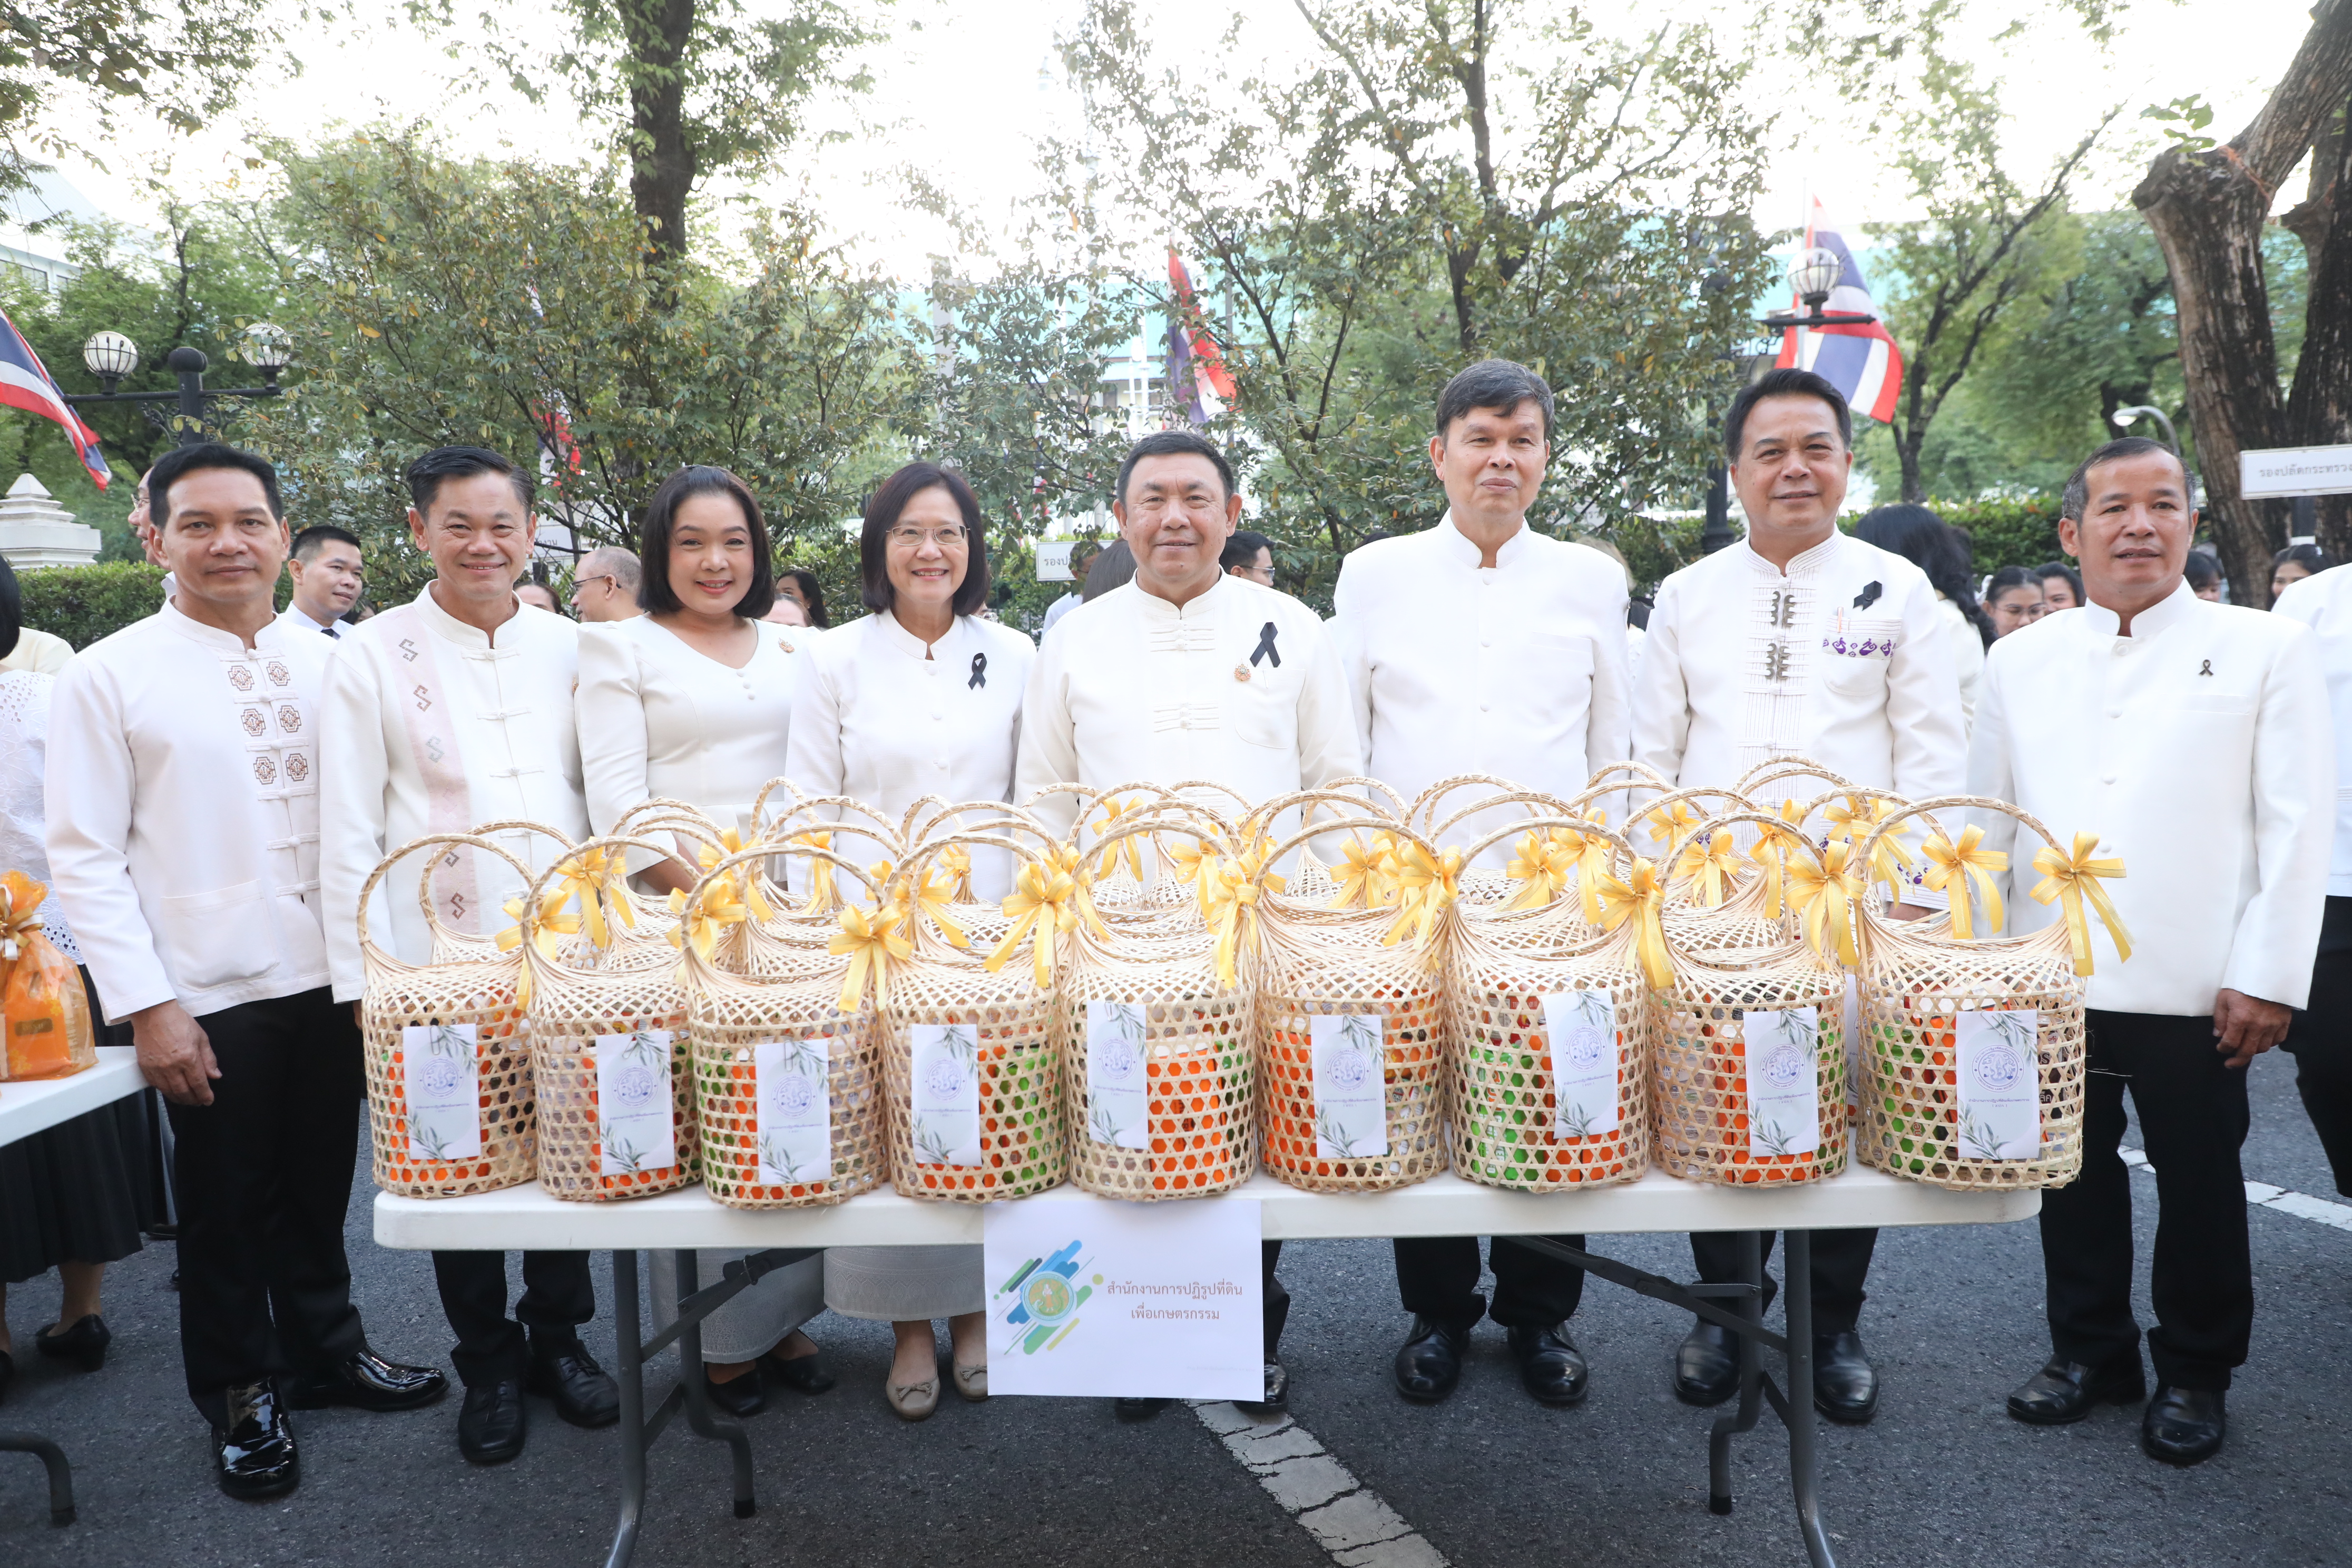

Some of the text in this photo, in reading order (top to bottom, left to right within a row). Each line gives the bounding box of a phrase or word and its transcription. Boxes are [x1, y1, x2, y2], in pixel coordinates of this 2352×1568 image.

[1108, 1278, 1242, 1299] สำนักงานการปฏิรูปที่ดิน
[1131, 1302, 1219, 1319] เพื่อเกษตรกรรม
